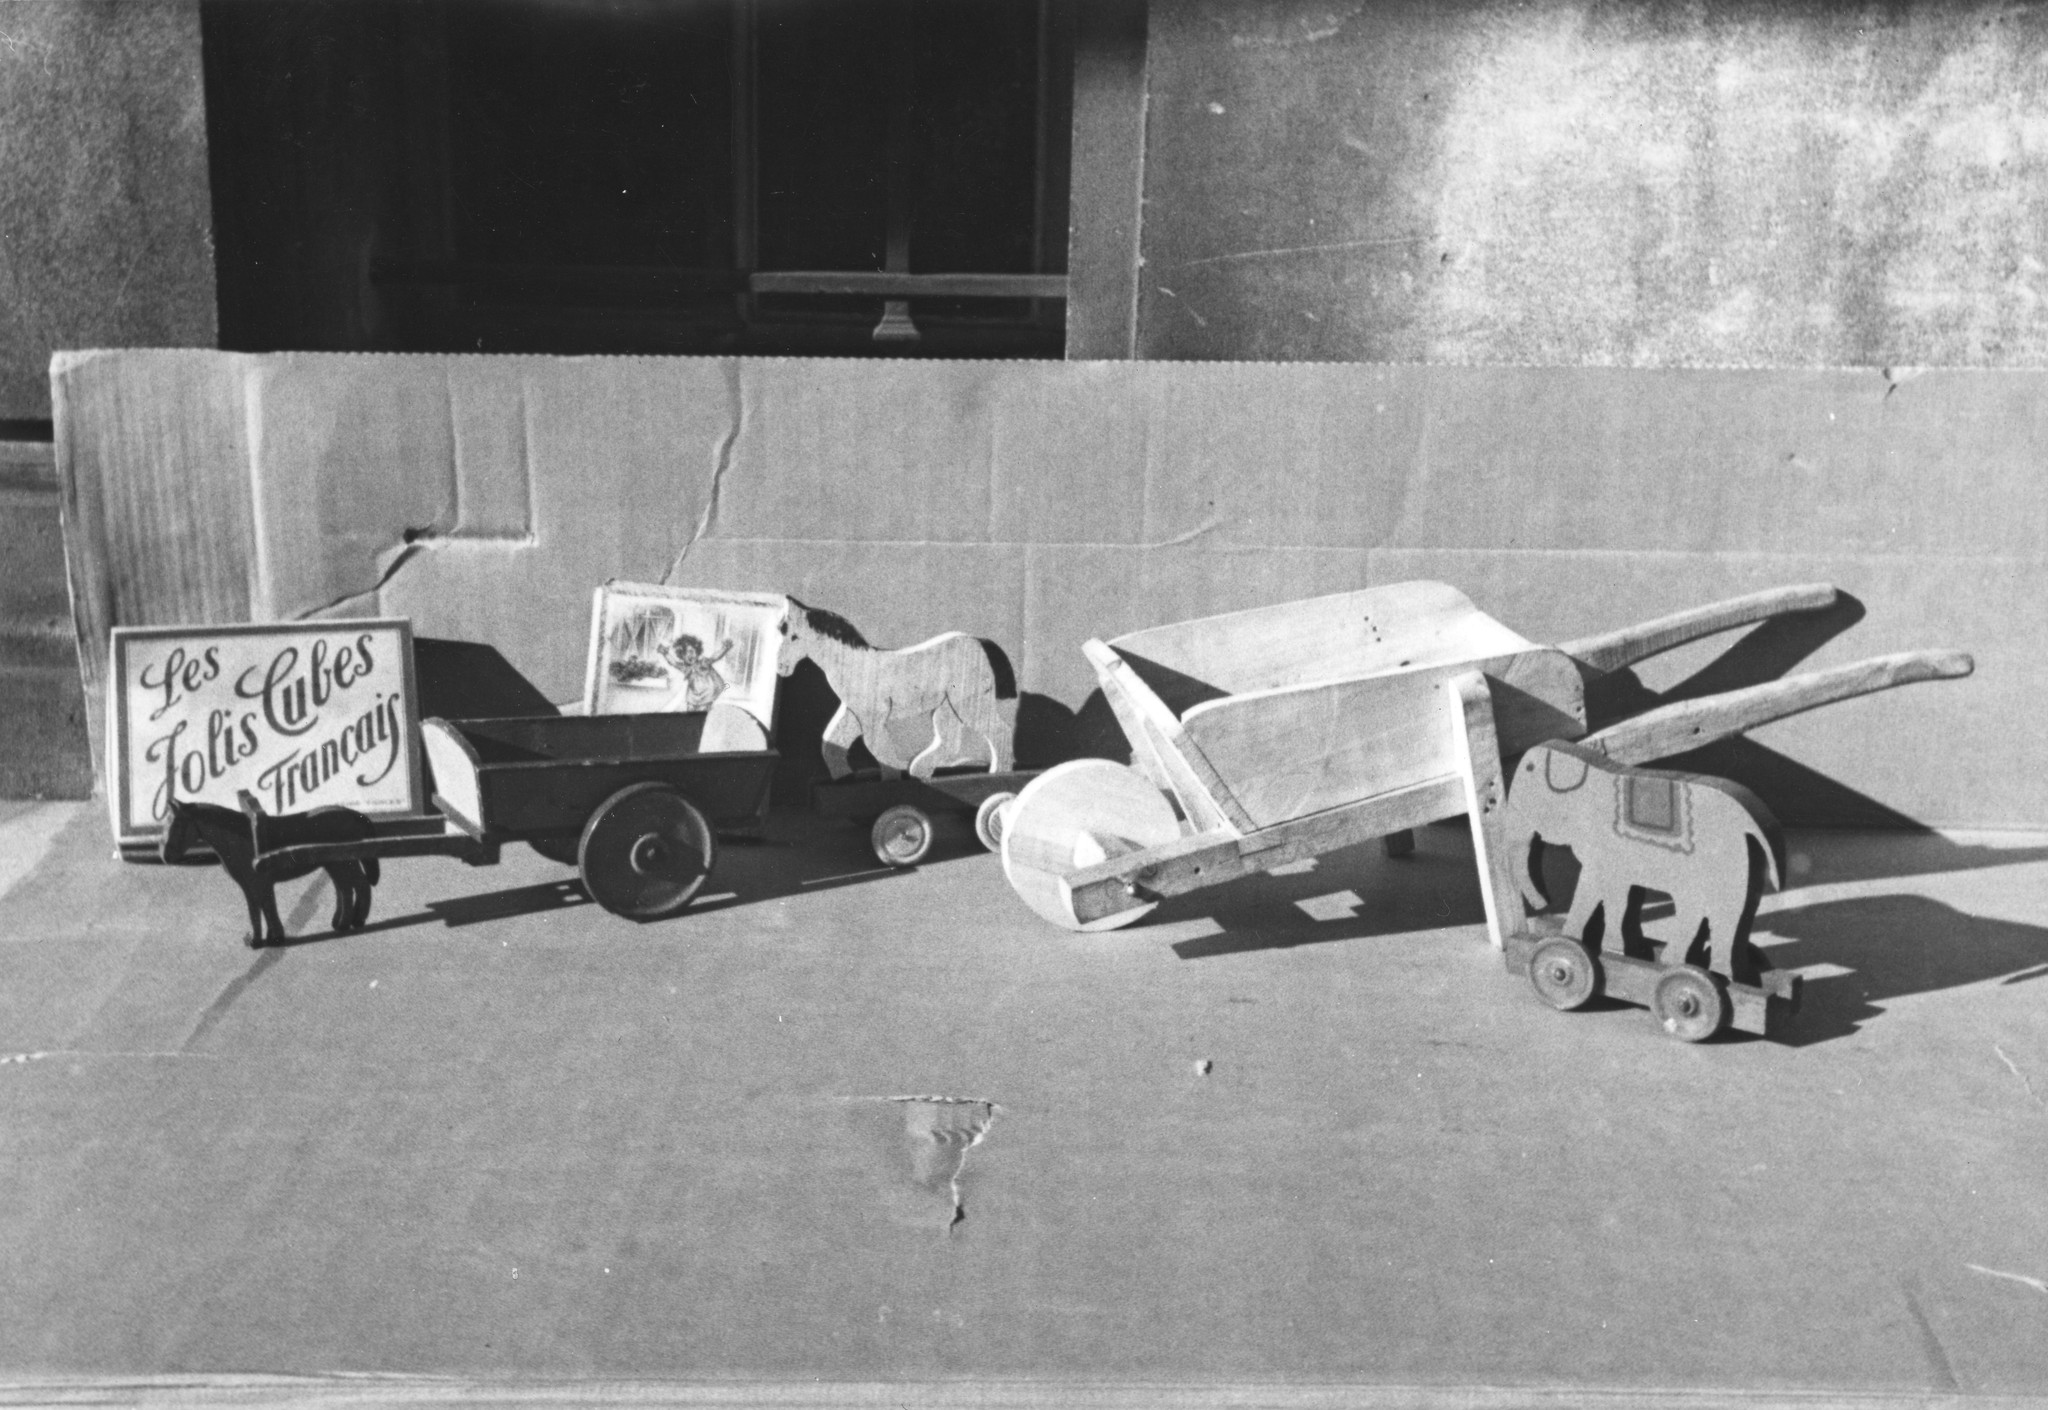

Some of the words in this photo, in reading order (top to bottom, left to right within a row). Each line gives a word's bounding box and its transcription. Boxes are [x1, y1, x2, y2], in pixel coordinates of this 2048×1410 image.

[140, 646, 220, 721] Les
[234, 633, 374, 737] Cubes
[145, 708, 259, 821] Jolis
[257, 692, 400, 815] Français
